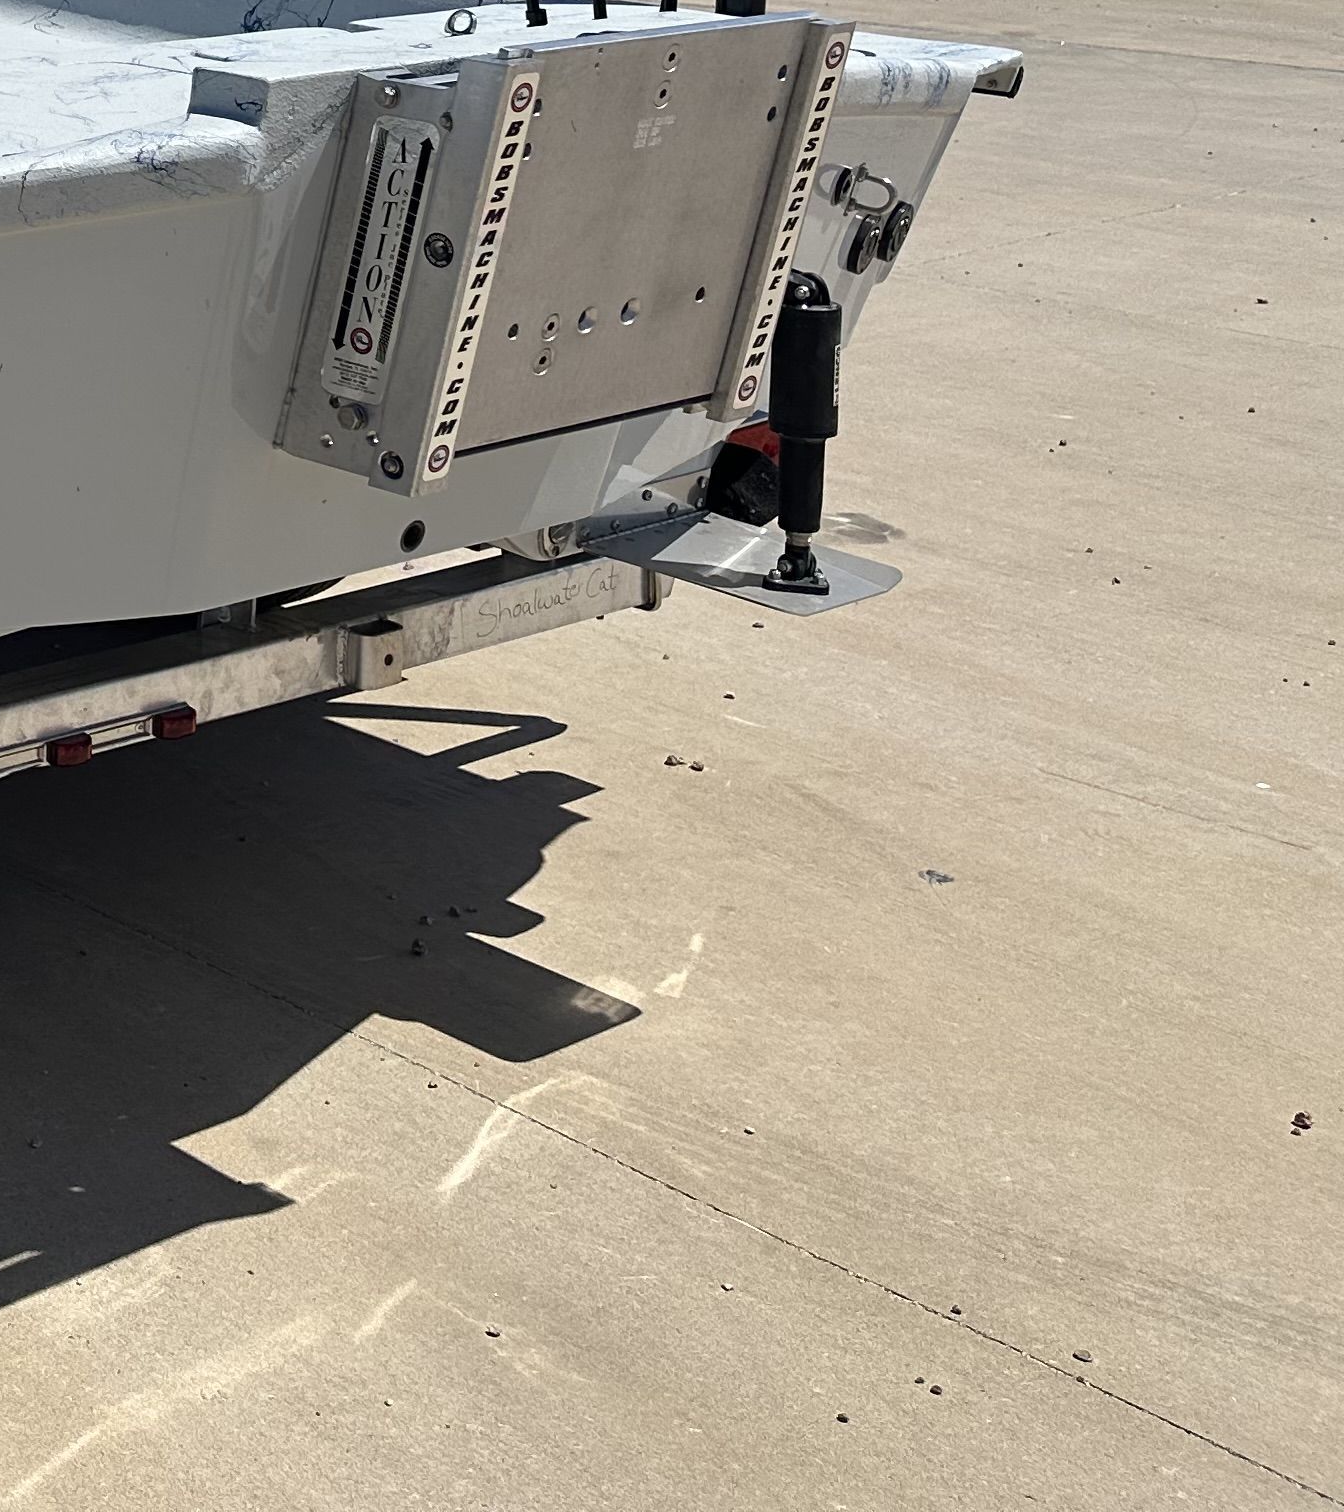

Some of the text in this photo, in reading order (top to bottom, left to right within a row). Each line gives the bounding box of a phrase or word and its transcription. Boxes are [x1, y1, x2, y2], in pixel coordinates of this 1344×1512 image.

[356, 137, 408, 325] ACTION
[475, 565, 619, 638] Shoalwater Cat
